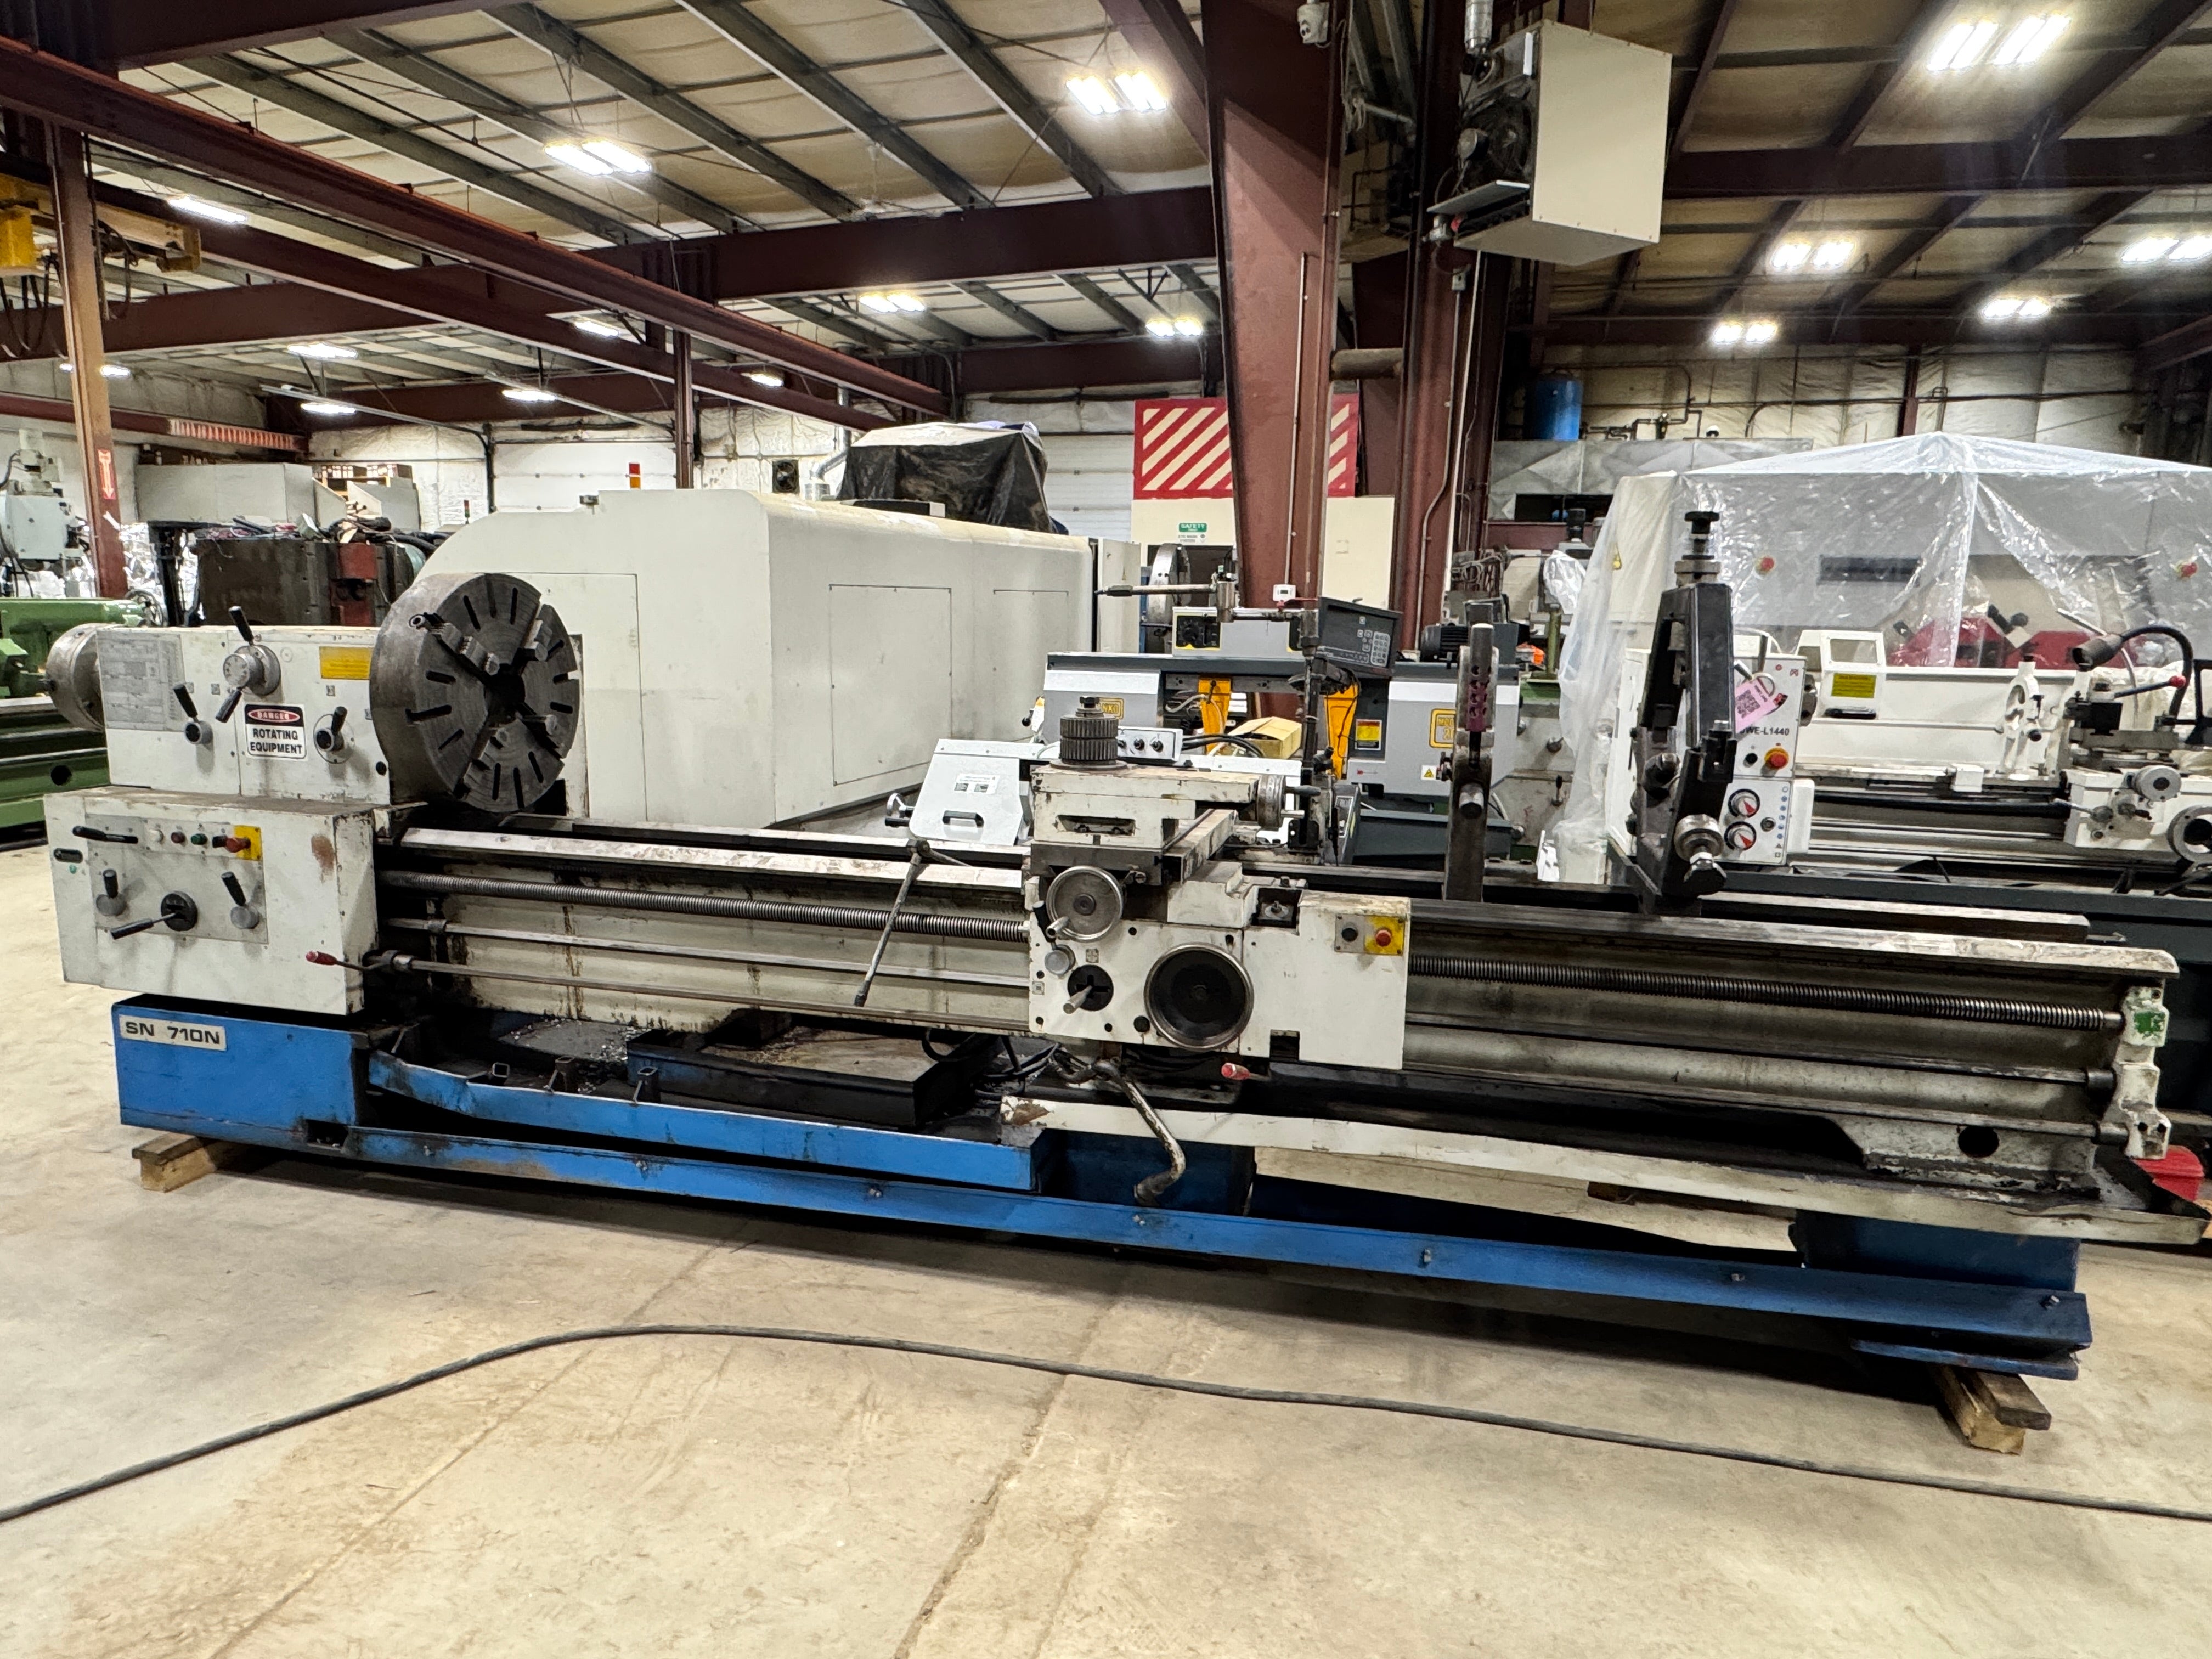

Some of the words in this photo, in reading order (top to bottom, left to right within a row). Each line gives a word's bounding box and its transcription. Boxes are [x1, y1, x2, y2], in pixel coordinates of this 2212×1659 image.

[252, 728, 298, 740] ROTATING
[250, 742, 303, 754] EQUIPMENT
[126, 1022, 155, 1036] SN
[167, 1026, 219, 1045] 710N
